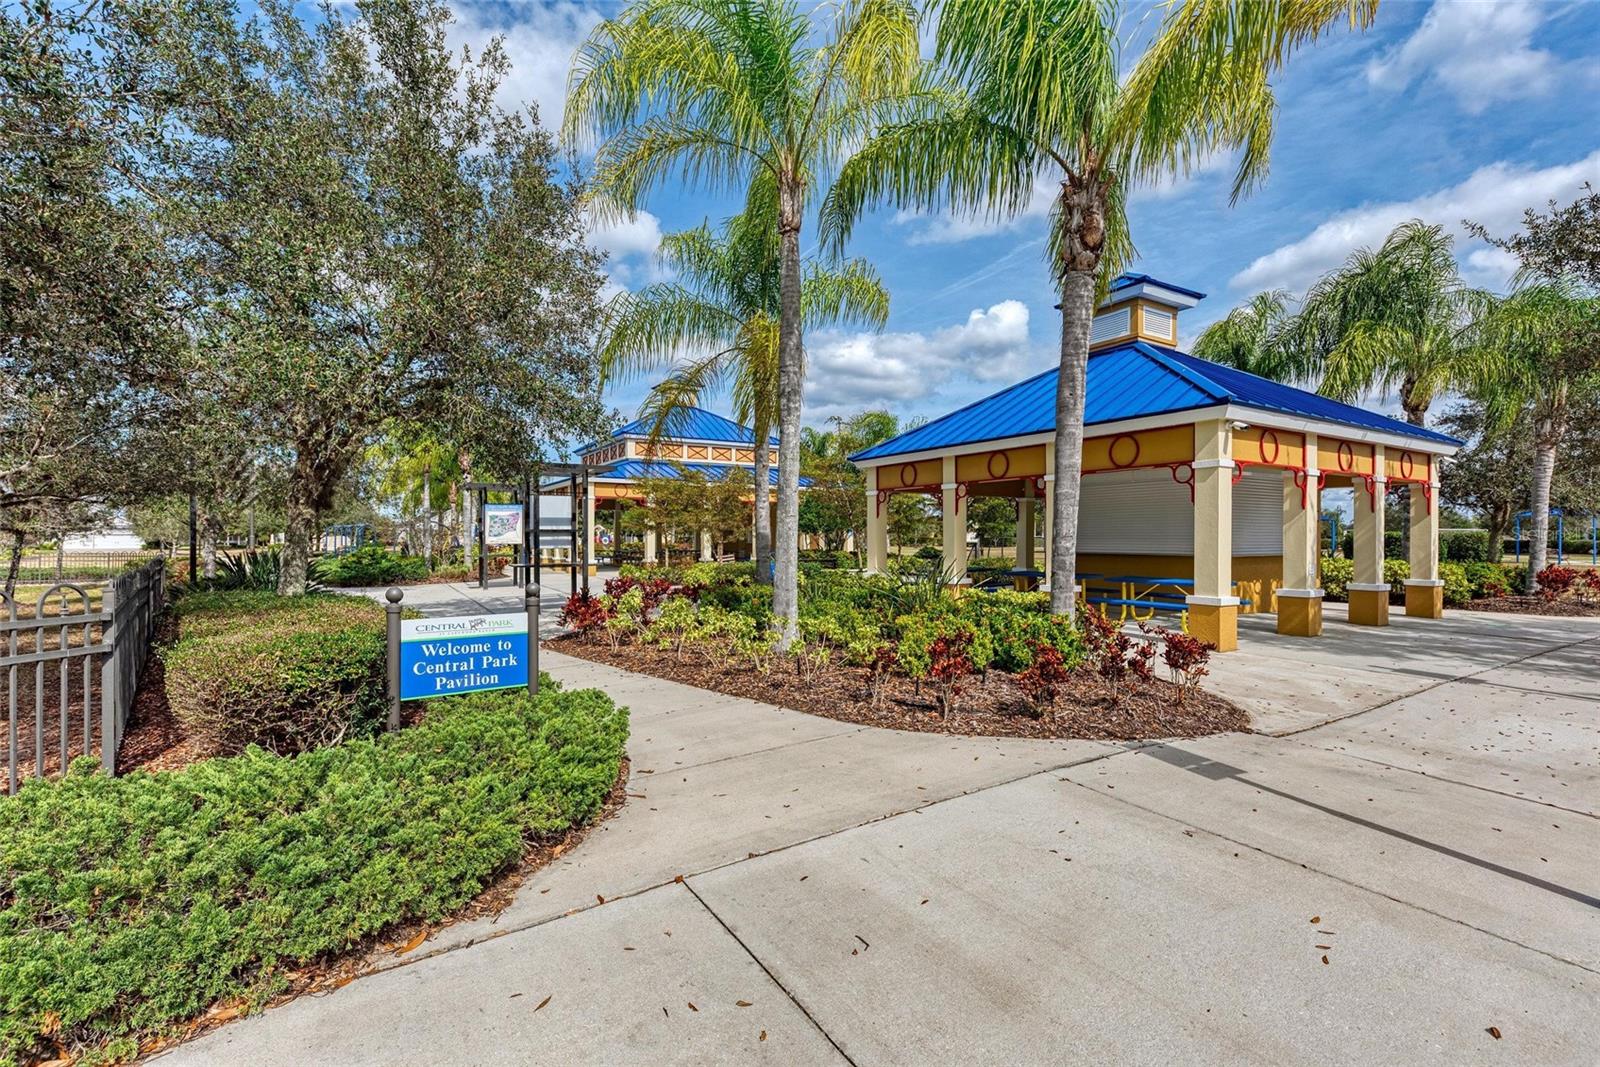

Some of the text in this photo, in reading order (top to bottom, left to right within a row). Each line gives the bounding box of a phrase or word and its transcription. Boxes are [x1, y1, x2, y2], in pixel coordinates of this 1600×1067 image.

[415, 619, 513, 632] CENTRAL PARK
[421, 639, 512, 657] Welcome to
[413, 653, 518, 676] Central Park
[435, 673, 499, 691] Pavilion
